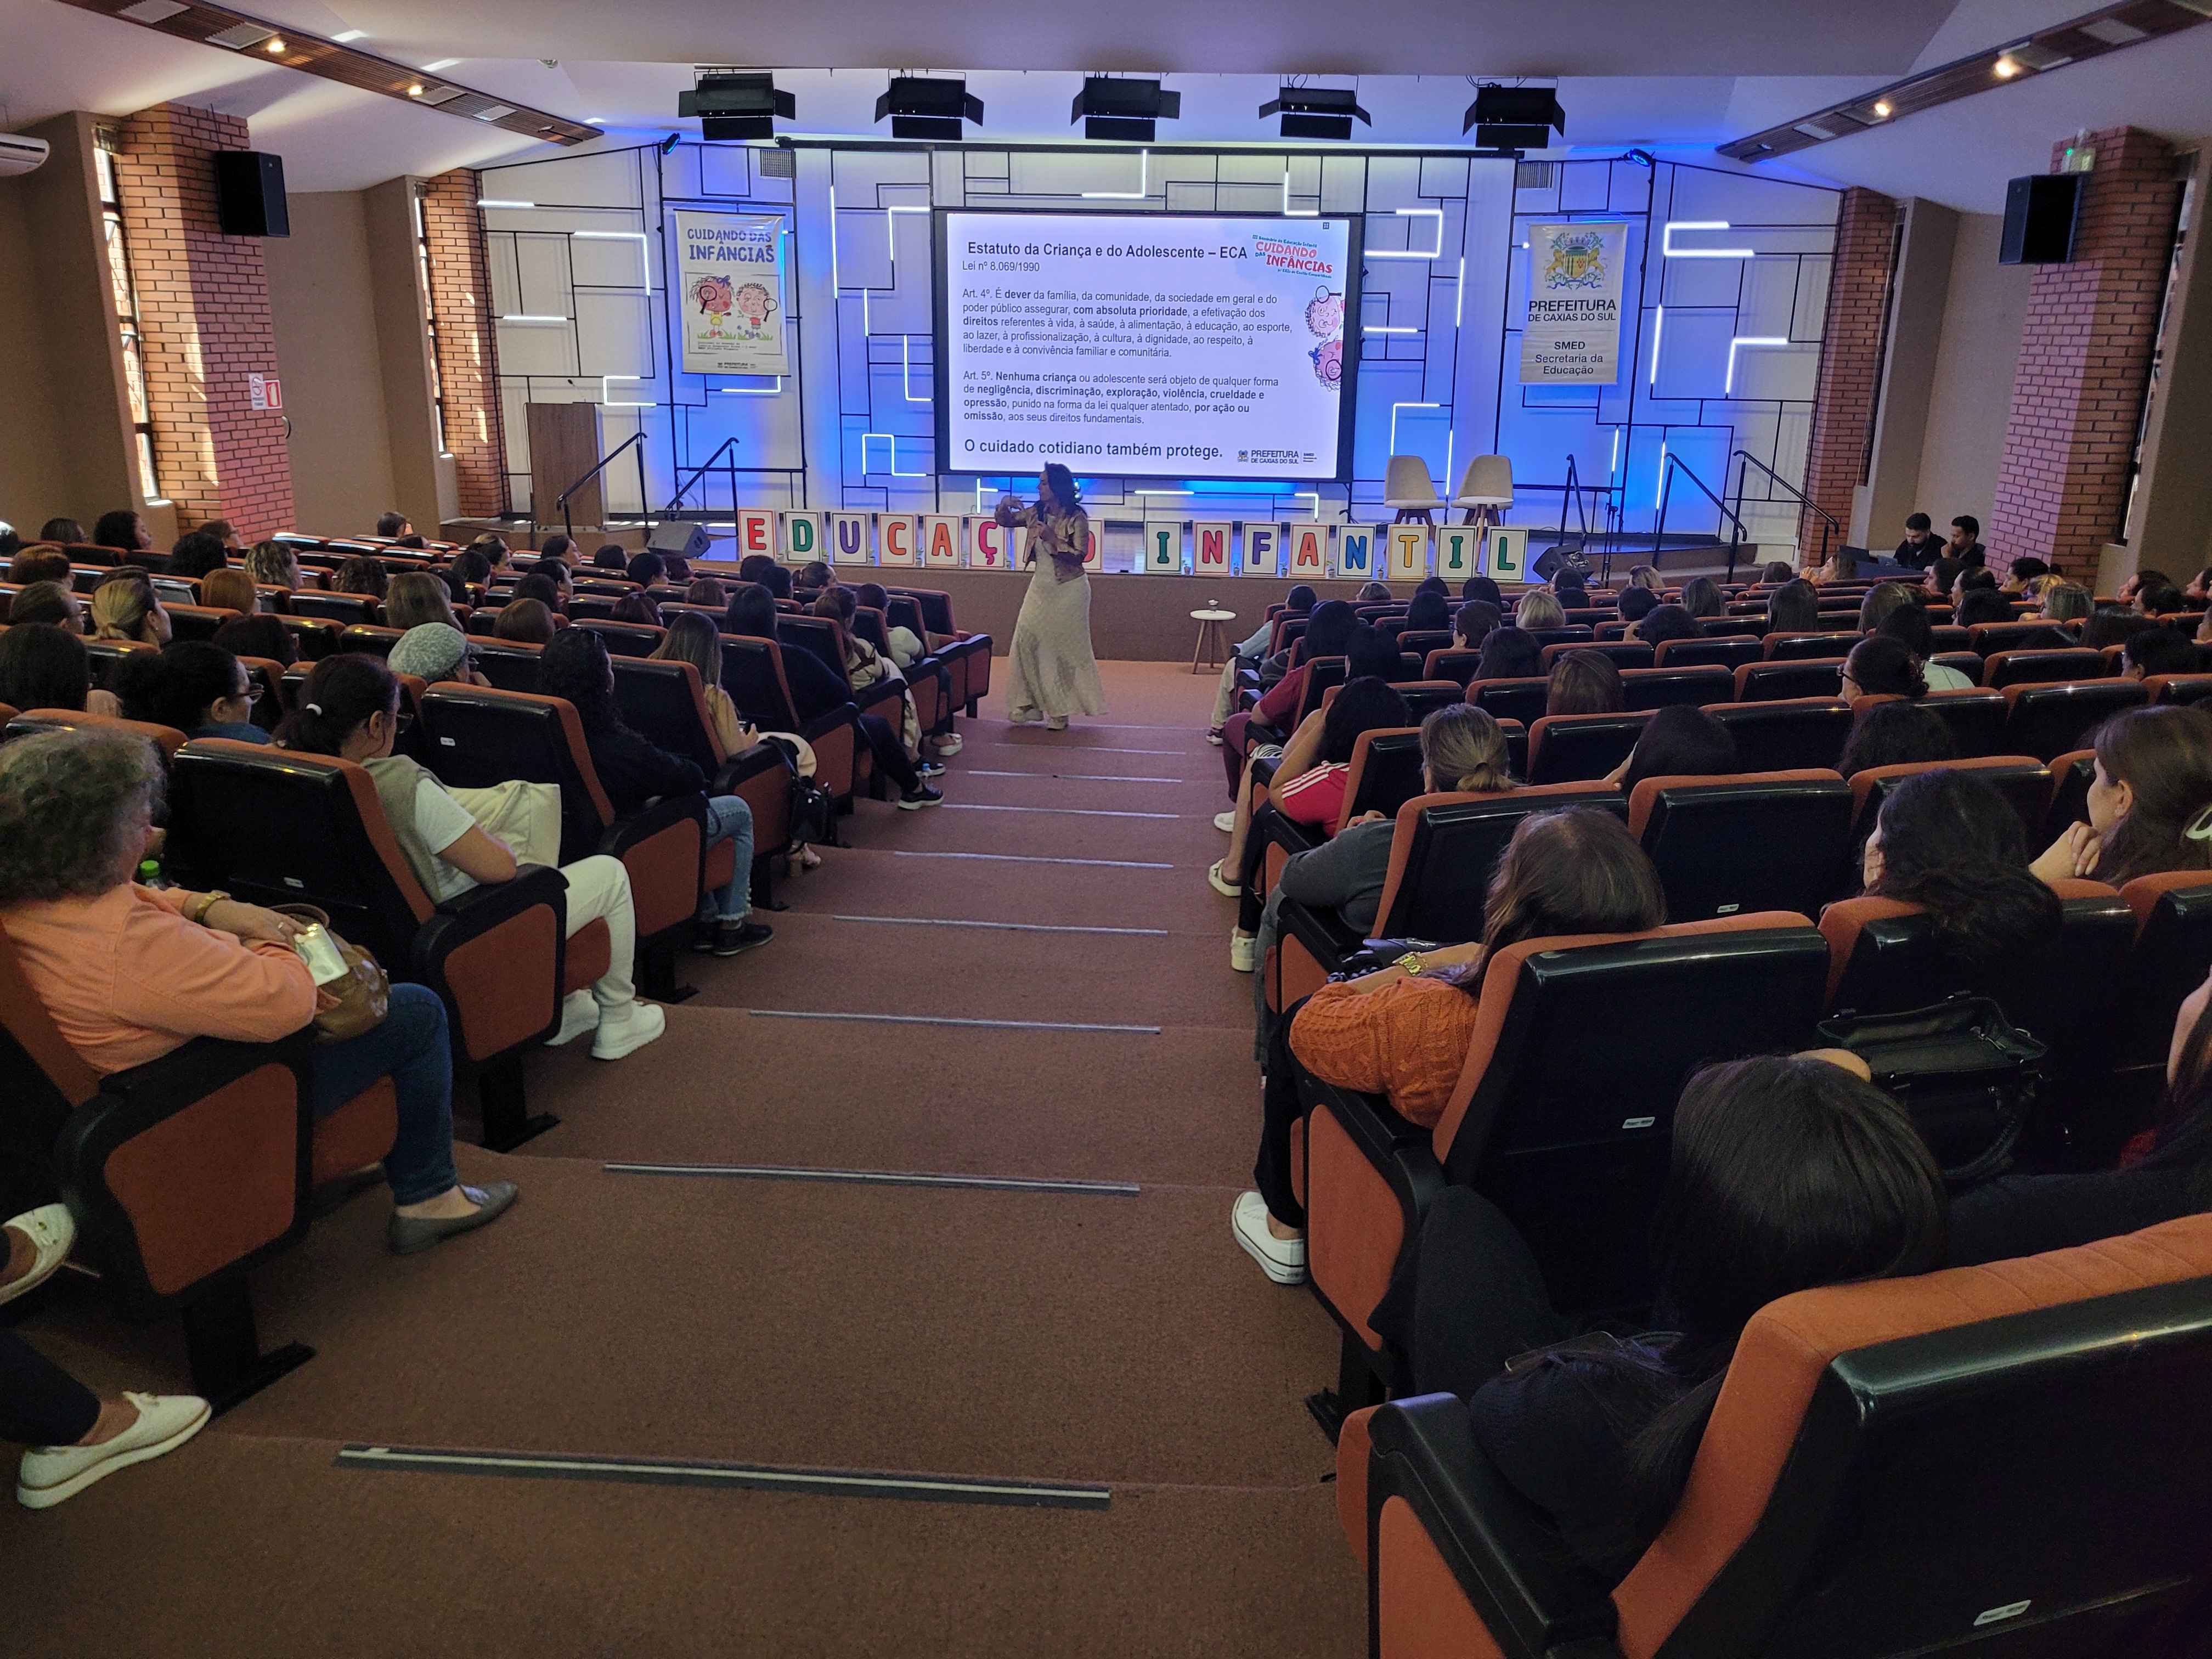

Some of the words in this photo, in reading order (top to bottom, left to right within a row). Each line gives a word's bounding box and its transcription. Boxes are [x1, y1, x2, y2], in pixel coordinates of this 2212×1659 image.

[687, 228, 746, 241] CUIDANDO
[749, 233, 772, 242] DAS
[689, 241, 775, 263] INFÂNCIAS
[968, 242, 1020, 255] Estatuto
[1025, 243, 1039, 255] da
[1044, 243, 1091, 258] Criança
[1096, 247, 1102, 256] e
[1107, 245, 1122, 256] do
[1126, 245, 1204, 258] Adolescente
[1220, 246, 1248, 258] ECA
[1256, 241, 1317, 258] CUIDANDO
[963, 261, 975, 270] Lei
[990, 262, 1040, 272] 8.069/1990
[1266, 255, 1333, 274] INFÂNCIAS
[962, 289, 978, 297] Art.
[996, 287, 1002, 298] É
[1005, 290, 1031, 298] dever
[1034, 290, 1044, 299] da
[1047, 290, 1078, 301] família,
[1082, 291, 1092, 300] da
[1096, 292, 1151, 303] comunidade,
[1155, 292, 1165, 301] da
[1169, 293, 1213, 302] sociedade
[1233, 294, 1255, 305] geral
[1266, 295, 1277, 303] do
[963, 303, 988, 314] poder
[991, 303, 1022, 314] público
[1025, 306, 1070, 315] assegurar,
[1097, 306, 1136, 315] absoluta
[1139, 306, 1189, 318] prioridade,
[1201, 307, 1246, 319] efetivação
[1249, 308, 1265, 317] dos
[1528, 299, 1616, 312] PREFEITURA
[963, 316, 998, 325] direitos
[1001, 317, 1045, 326] referentes
[1048, 318, 1053, 327] à
[1056, 318, 1076, 329] vida,
[1080, 318, 1085, 328] à
[1088, 319, 1116, 330] saúde,
[1120, 319, 1125, 328] à
[1128, 320, 1183, 331] alimentação,
[1187, 320, 1192, 330] à
[1195, 321, 1240, 332] educação,
[1257, 323, 1292, 334] esporte,
[1528, 314, 1541, 322] DE
[1543, 313, 1578, 321] CAXIAS
[1581, 313, 1595, 321] DO
[1597, 313, 1616, 321] SUL
[977, 330, 1000, 341] lazer,
[1003, 331, 1008, 340] à
[1011, 331, 1091, 344] profissionalização,
[1094, 332, 1099, 342] à
[1102, 334, 1134, 344] cultura,
[1137, 334, 1142, 342] à
[1146, 334, 1190, 345] dignidade,
[1207, 336, 1244, 347] respeito,
[1248, 336, 1252, 345] à
[1554, 341, 1585, 351] SMED
[963, 343, 1003, 353] liberdade
[1014, 345, 1019, 353] à
[1023, 345, 1073, 354] convivência
[1076, 346, 1108, 356] familiar
[1119, 347, 1171, 357] comunitária.
[1535, 354, 1587, 363] Secretaria
[1590, 354, 1604, 363] da
[1543, 366, 1594, 376] Educação
[963, 371, 978, 380] Art.
[996, 371, 1040, 381] Nenhuma
[1043, 373, 1076, 384] criança
[1093, 374, 1145, 383] adolescente
[1148, 375, 1167, 383] será
[1170, 375, 1196, 386] objeto
[1199, 376, 1210, 385] de
[1212, 376, 1251, 387] qualquer
[1254, 377, 1278, 386] forma
[964, 384, 974, 393] de
[978, 385, 1032, 396] negligência,
[1036, 386, 1103, 398] discriminação,
[1107, 388, 1160, 399] exploração,
[1163, 388, 1207, 399] violência,
[1210, 390, 1256, 399] crueldade
[964, 399, 1009, 409] opressão,
[1012, 399, 1041, 409] punido
[1058, 400, 1082, 409] forma
[1085, 400, 1095, 409] da
[1098, 400, 1108, 409] lei
[1110, 402, 1149, 413] qualquer
[1151, 403, 1191, 413] atentado,
[1195, 405, 1210, 414] por
[1213, 404, 1235, 414] ação
[964, 411, 1005, 421] omissão,
[1049, 413, 1081, 422] direitos
[1084, 414, 1144, 424] fundamentais.
[965, 439, 974, 452] O
[980, 440, 1034, 453] cuidado
[1039, 441, 1102, 454] cotidiano
[1107, 443, 1161, 456] também
[1167, 445, 1222, 460] protege.
[1251, 450, 1299, 458] PREFEITURA
[748, 518, 1096, 565] EDUCAÇ
[1157, 531, 1516, 571] INFANTIL
